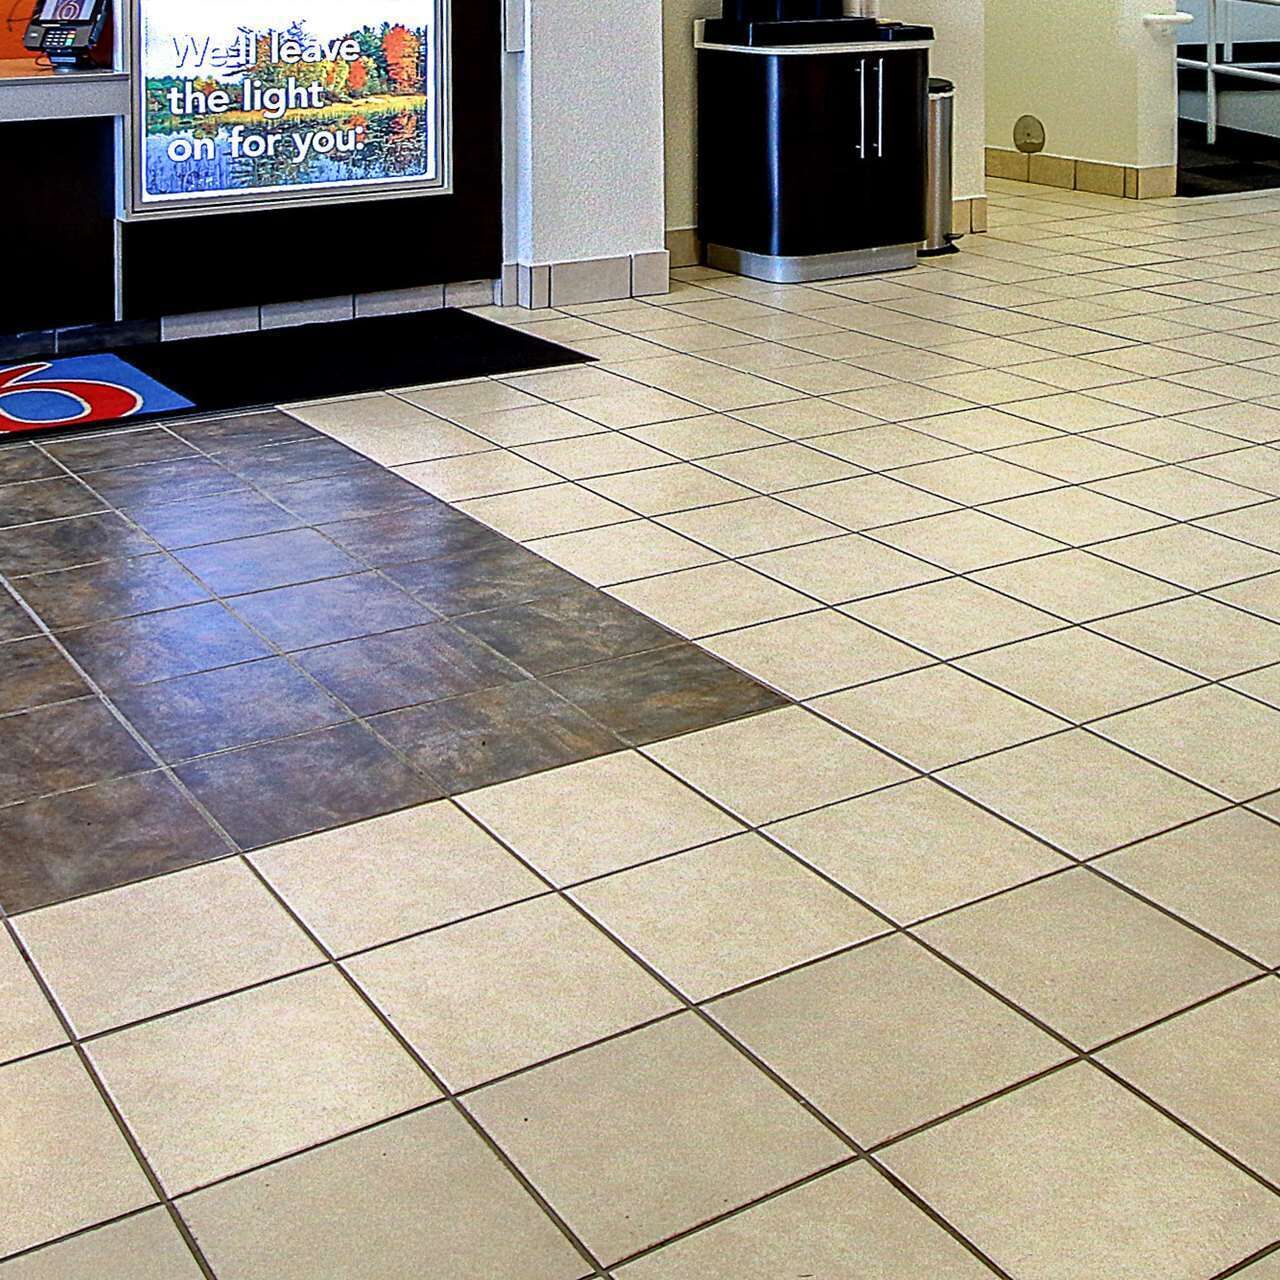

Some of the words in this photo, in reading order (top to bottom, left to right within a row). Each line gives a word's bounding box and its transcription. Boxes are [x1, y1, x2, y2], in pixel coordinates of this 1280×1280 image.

[271, 31, 361, 65] leave
[167, 80, 230, 116] the
[243, 77, 324, 120] light
[167, 135, 215, 163] on
[230, 125, 284, 159] for
